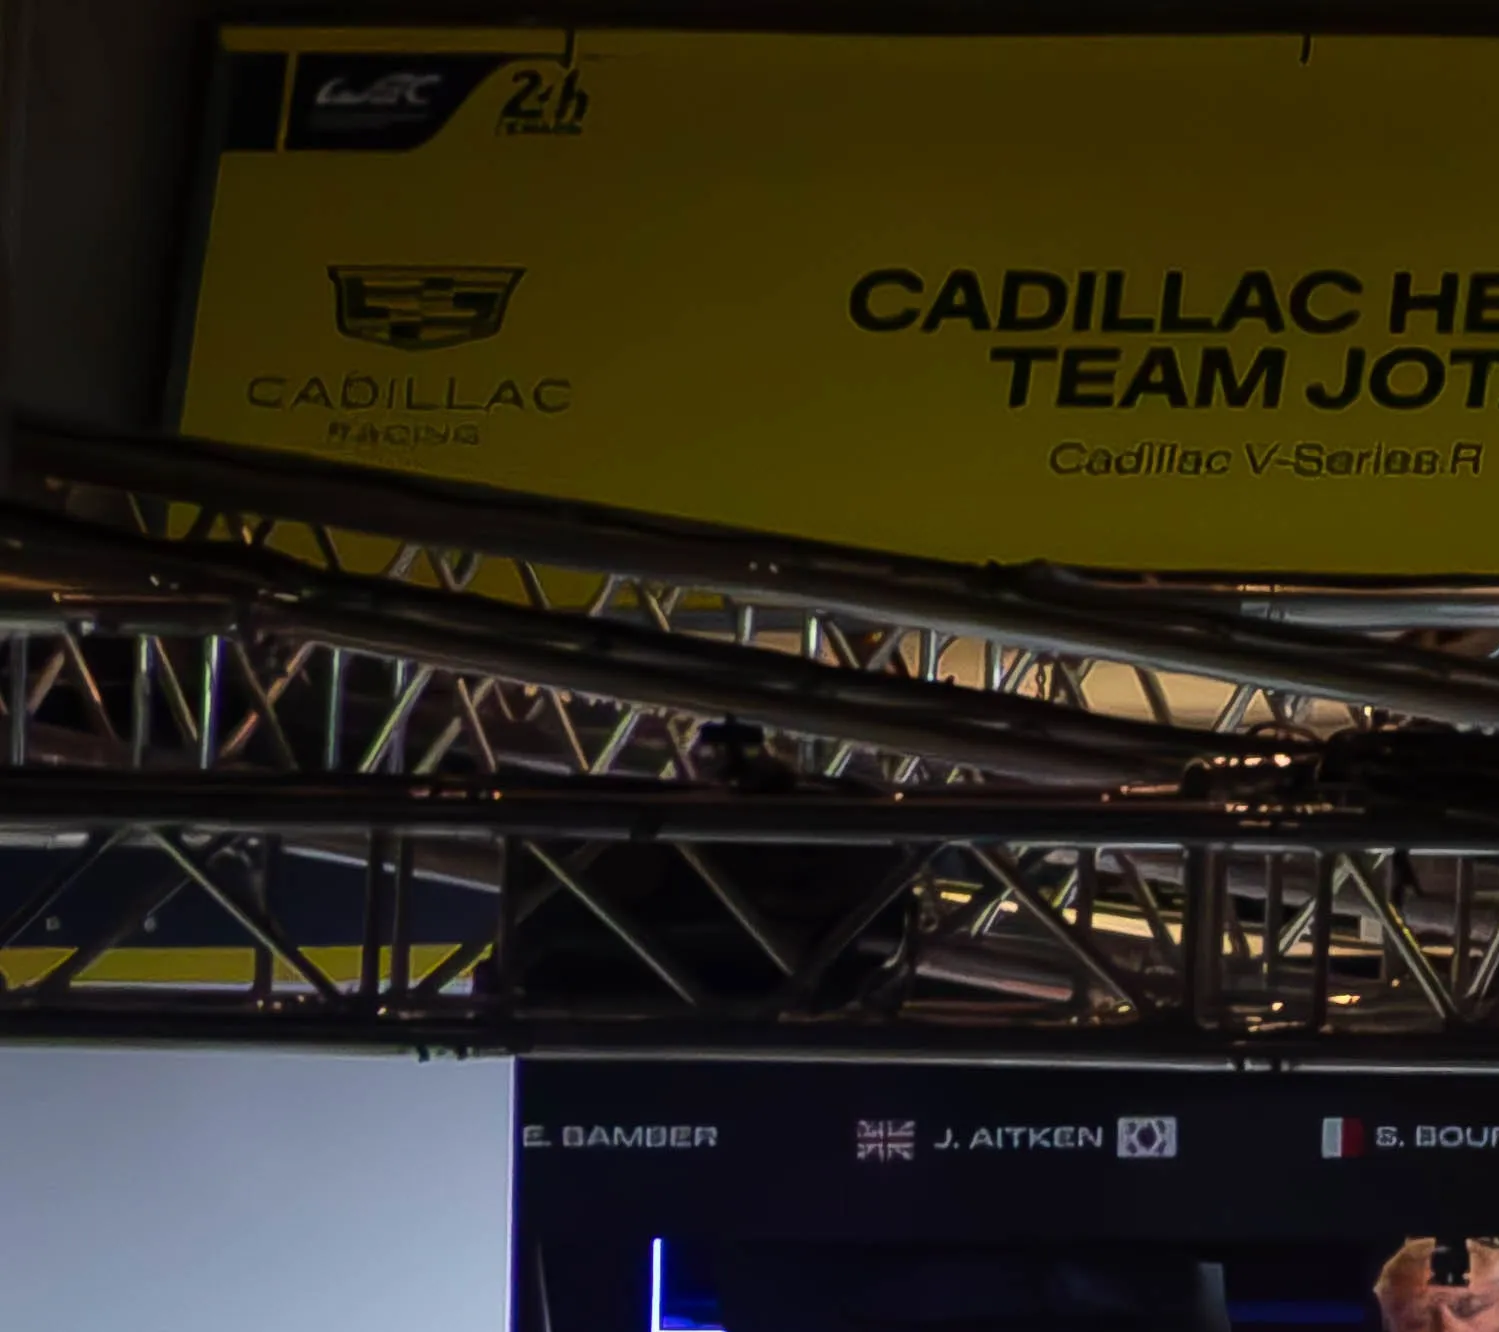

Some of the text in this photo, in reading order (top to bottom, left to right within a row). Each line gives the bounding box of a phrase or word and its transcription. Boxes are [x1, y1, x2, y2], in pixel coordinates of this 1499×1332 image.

[848, 268, 1365, 335] CADILLAC
[245, 376, 573, 414] CADILLAC
[988, 346, 1288, 411] TEAM
[1049, 440, 1484, 479] Cadillac V-Series.R
[561, 1123, 720, 1150] BAMBER
[932, 1124, 1104, 1151] J. AITKEN
[1375, 1124, 1406, 1150] S.
